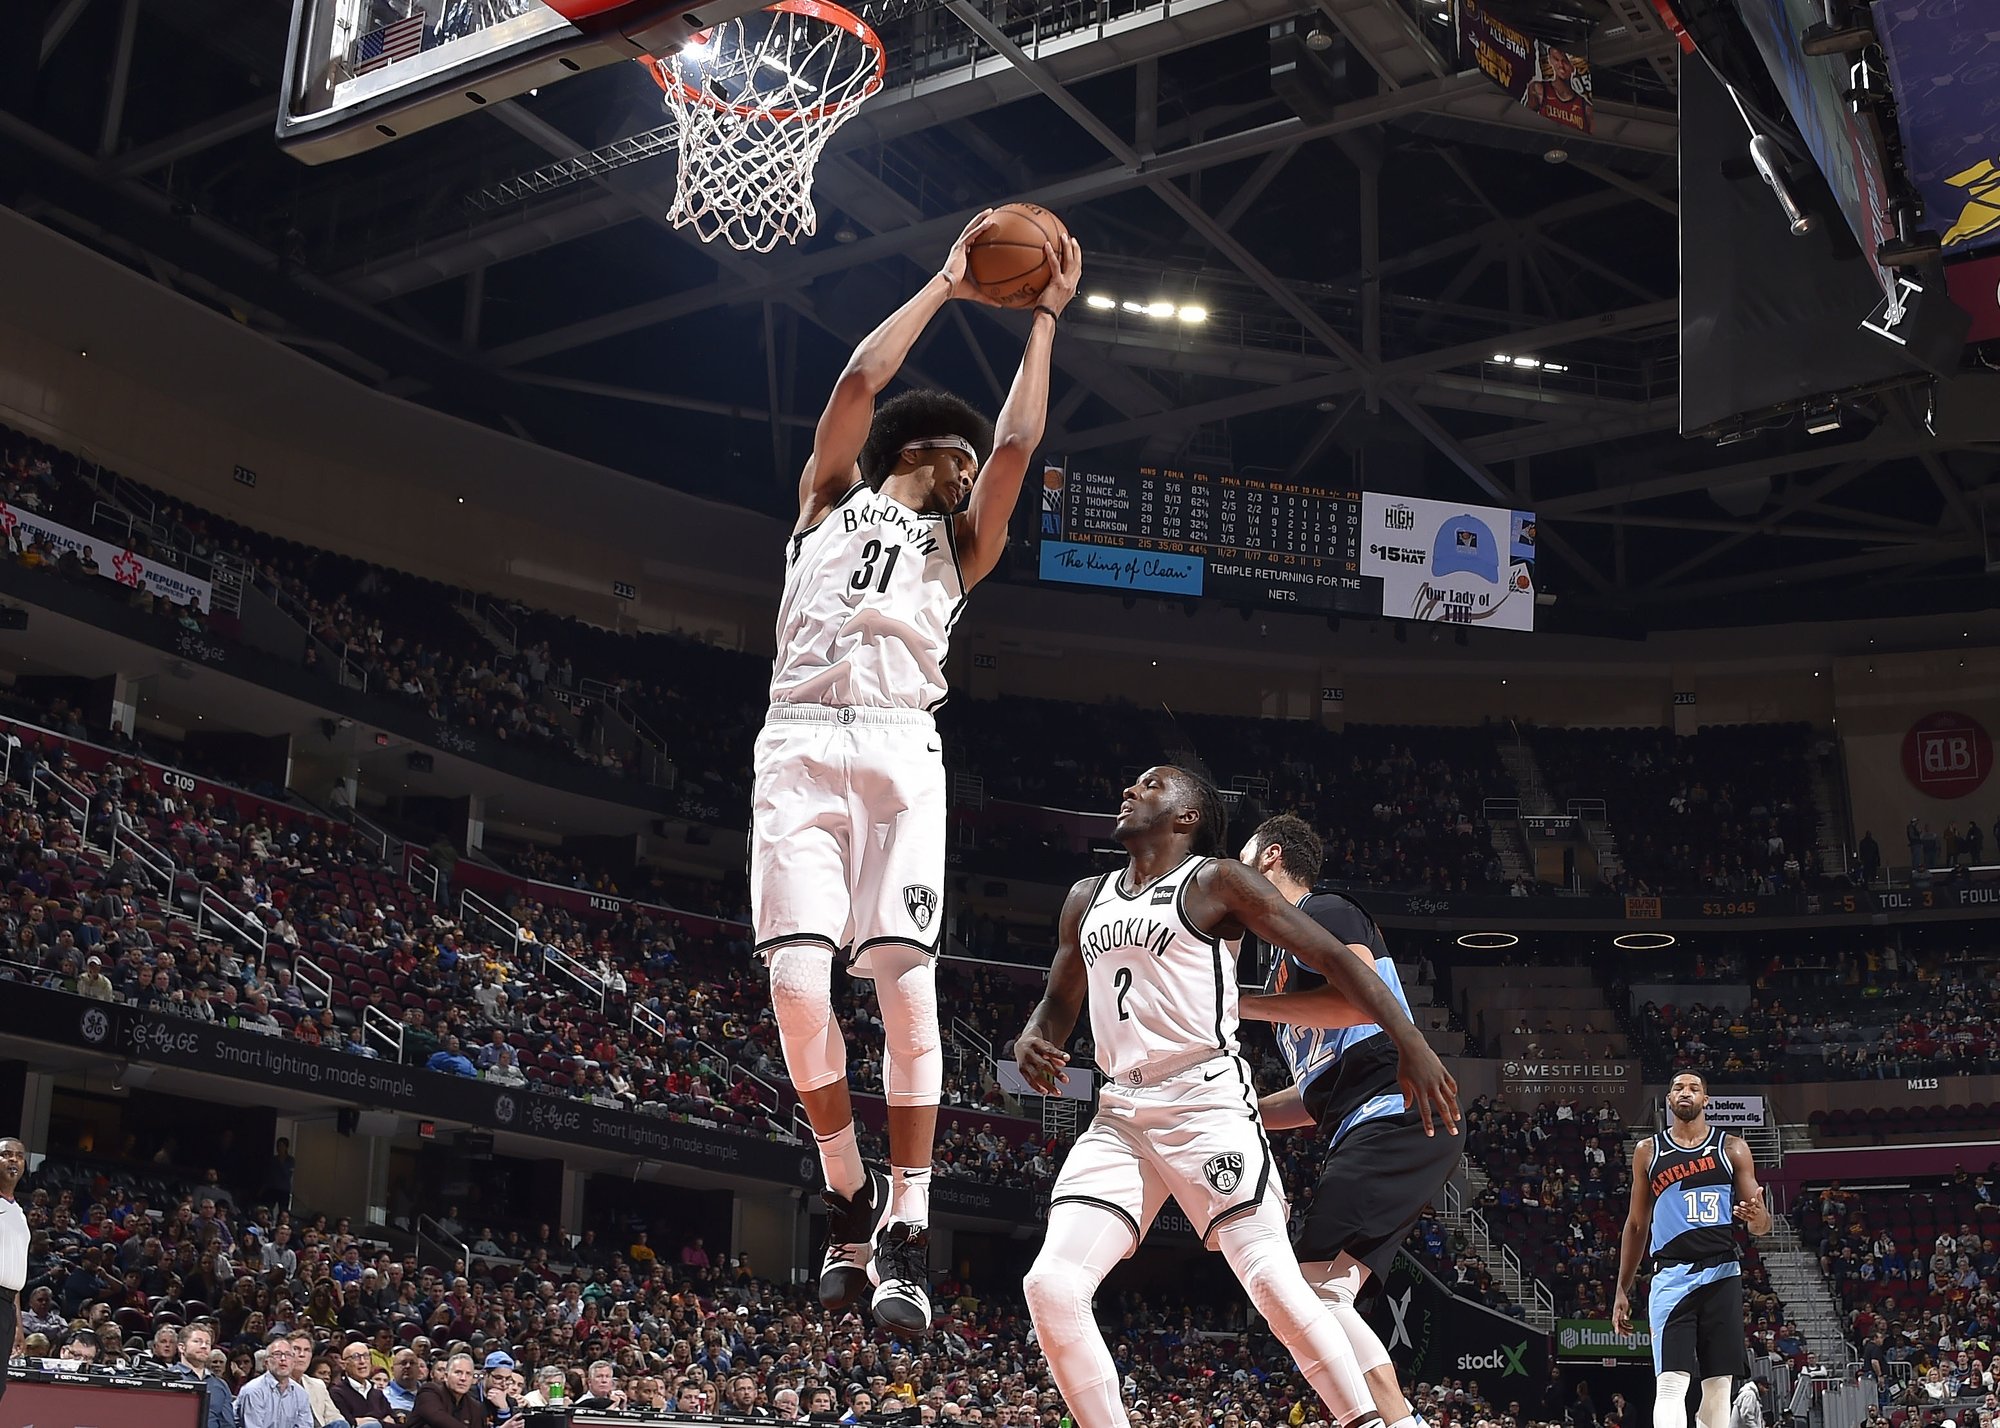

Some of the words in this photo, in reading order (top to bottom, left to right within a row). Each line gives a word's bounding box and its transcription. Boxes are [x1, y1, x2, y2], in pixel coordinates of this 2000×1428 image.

[1546, 104, 1584, 130] CLEVELAND
[235, 467, 256, 486] 212
[1072, 472, 1081, 481] 16
[1086, 474, 1115, 485] OSMAN
[1142, 480, 1154, 489] 26
[1165, 483, 1180, 493] 5/6
[1191, 486, 1210, 497] 83%
[1223, 489, 1235, 500] 1/2
[1247, 493, 1262, 502] 2/3
[1328, 502, 1338, 511] -8
[1348, 504, 1357, 513] 13
[1285, 484, 1298, 493] AST
[1070, 484, 1081, 493] 22
[1086, 485, 1112, 496] NANCE
[1115, 489, 1129, 499] JR.
[1141, 492, 1153, 501] 28
[1164, 494, 1182, 505] 8/13
[1191, 497, 1209, 508] 62%
[1221, 501, 1237, 511] 2/5
[1247, 504, 1262, 514] 2/2
[1271, 506, 1280, 516] 10
[1347, 516, 1358, 525] 20
[1071, 495, 1080, 504] 13
[1086, 496, 1130, 509] THOMPSON
[1141, 503, 1153, 512] 28
[1164, 505, 1179, 515] 3/7
[1190, 509, 1209, 519] 43%
[1221, 512, 1236, 522] 0/0
[1248, 515, 1260, 525] 1/4
[1314, 523, 1320, 532] 2
[1327, 524, 1337, 533] -9
[1348, 527, 1354, 535] 7
[1385, 508, 1414, 526] HIGH
[843, 504, 939, 556] BROOKLYN
[1071, 506, 1078, 515] 2
[1084, 508, 1117, 520] SEXTON
[1140, 514, 1152, 523] 29
[1163, 516, 1181, 527] 6/19
[1190, 520, 1208, 530] 32%
[1222, 523, 1234, 533] 1/5
[1249, 526, 1259, 536] 1/1
[1271, 529, 1277, 538] 3
[1287, 531, 1294, 540] 2
[1300, 533, 1307, 541] 0
[1314, 534, 1320, 543] 0
[1327, 535, 1337, 544] -8
[1347, 538, 1355, 547] 14
[1384, 523, 1414, 531] LIGHT
[1071, 518, 1078, 527] 8
[1084, 519, 1128, 532] CLARKSON
[1141, 525, 1150, 534] 21
[1162, 528, 1180, 538] 5/12
[1189, 531, 1208, 541] 42%
[1220, 535, 1235, 545] 3/5
[1246, 537, 1261, 547] 2/3
[1287, 542, 1293, 551] 3
[1300, 543, 1306, 552] 0
[1328, 546, 1335, 555] 0
[1347, 549, 1355, 558] 15
[1069, 532, 1091, 541] TEAM
[1094, 535, 1125, 546] TOTALS
[1138, 539, 1152, 548] 215
[1158, 541, 1184, 552] 35/80
[1189, 545, 1207, 555] 44%
[1217, 548, 1237, 558] 11/27
[1245, 551, 1261, 560] 11/17
[1267, 554, 1279, 562] 40
[1284, 555, 1295, 564] 23
[1300, 557, 1306, 566] 11
[1313, 558, 1321, 567] 13
[1345, 562, 1357, 571] 92
[1370, 544, 1401, 562] $15
[1401, 548, 1426, 556] CLASSIC
[1401, 555, 1426, 565] HAT
[851, 539, 901, 594] 31
[1055, 552, 1083, 570] The
[1087, 559, 1120, 581] King
[1124, 559, 1141, 583] of
[1210, 563, 1252, 578] TEMPLE
[1255, 568, 1314, 585] RETURNING
[1316, 574, 1339, 587] FOR
[1341, 577, 1361, 589] THE
[145, 570, 196, 596] REPUBLIC
[616, 583, 635, 598] 213
[1268, 589, 1298, 602] NETS.
[1450, 589, 1477, 606] Lady
[1479, 593, 1490, 606] of
[1443, 604, 1472, 623] THE
[975, 655, 994, 667] 214
[1323, 689, 1343, 700] 215
[1674, 694, 1695, 703] 216
[1925, 737, 1971, 772] AB
[163, 771, 171, 785] C
[174, 775, 196, 792] 109
[1223, 795, 1239, 803] 215
[1529, 820, 1545, 828] 215
[1554, 820, 1571, 828] 216
[908, 888, 936, 911] NETS
[1153, 890, 1173, 899] infor
[1833, 895, 1855, 913] -5
[1879, 893, 1912, 909] TOL:
[1922, 891, 1934, 908] 3
[1703, 902, 1756, 917] $3,945
[1082, 917, 1176, 968] BROOKLYN
[1114, 967, 1133, 1021] 2
[150, 1023, 175, 1053] by
[176, 1033, 199, 1054] GE
[215, 1041, 262, 1067] Smart
[265, 1050, 322, 1082] lighting,
[326, 1065, 366, 1088] made
[369, 1076, 416, 1097] simple.
[1524, 1064, 1626, 1077] WESTFIELD
[1505, 1085, 1588, 1095] CHAMPIONS
[1593, 1085, 1626, 1095] CLUB
[1908, 1078, 1939, 1090] M113
[1715, 1100, 1745, 1110] below.
[1705, 1113, 1730, 1121] before
[1731, 1114, 1746, 1122] you
[1747, 1113, 1761, 1122] dig.
[592, 1118, 626, 1139] Smart
[628, 1122, 671, 1150] lighting,
[673, 1135, 703, 1154] made
[704, 1141, 740, 1162] simple.
[1206, 1154, 1242, 1178] NETS
[1651, 1156, 1716, 1197] CLEVELAND
[1683, 1191, 1720, 1223] 13
[1457, 1340, 1529, 1378] stockX
